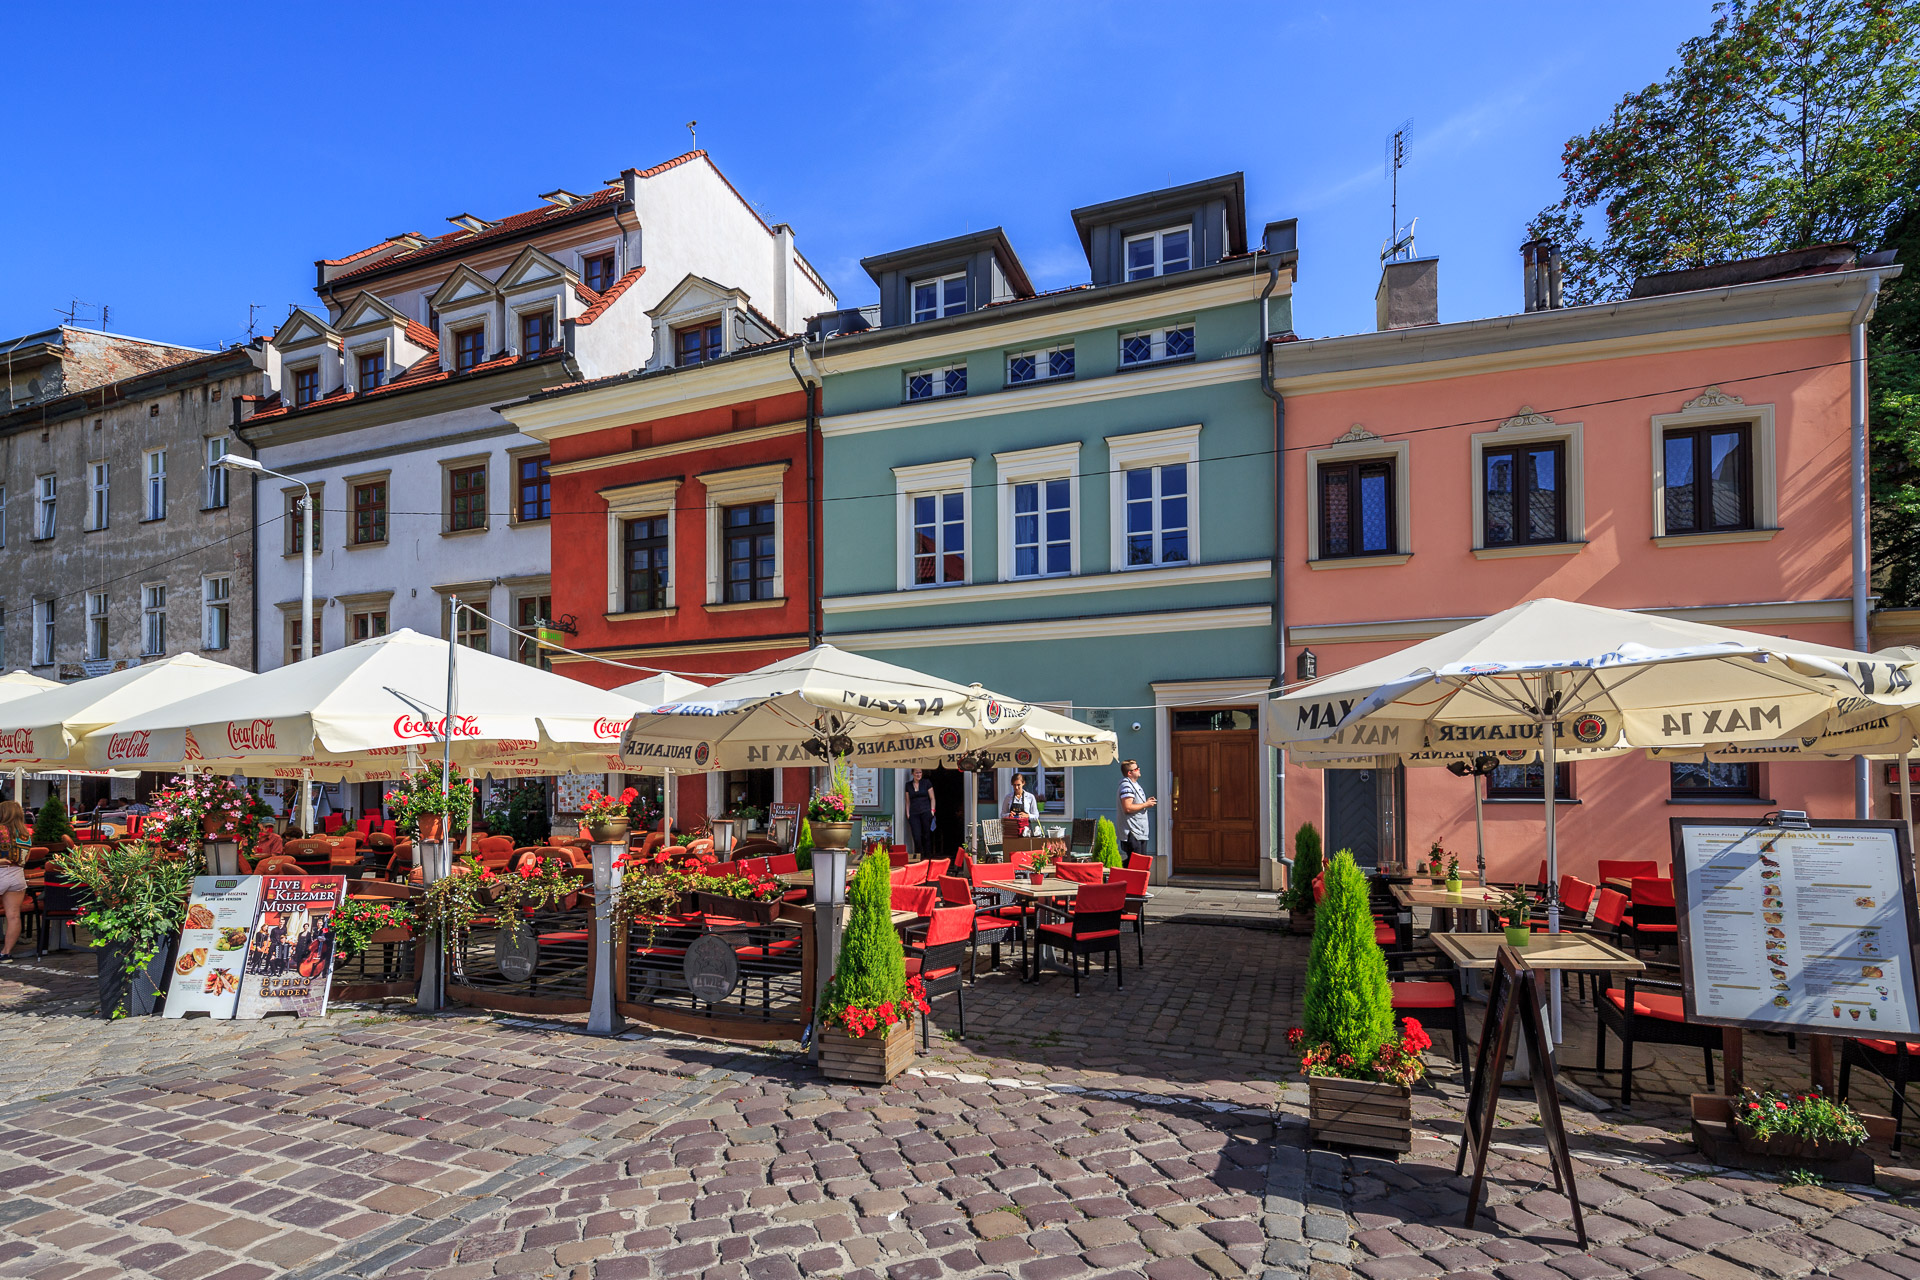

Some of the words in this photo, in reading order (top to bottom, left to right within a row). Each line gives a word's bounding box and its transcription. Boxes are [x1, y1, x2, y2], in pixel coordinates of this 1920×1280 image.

[917, 697, 944, 716] 14
[1297, 698, 1355, 731] MAX
[227, 719, 278, 751] Coca-Cola
[393, 714, 481, 739] Coca-Cola
[0, 727, 35, 755] oca-Cola
[107, 730, 151, 760] Coca-Cola
[268, 878, 300, 890] LIVE
[274, 889, 335, 901] KLEZMER
[260, 900, 306, 912] MUSIC
[262, 977, 311, 987] ETHNO
[259, 987, 310, 997] GARDEN
